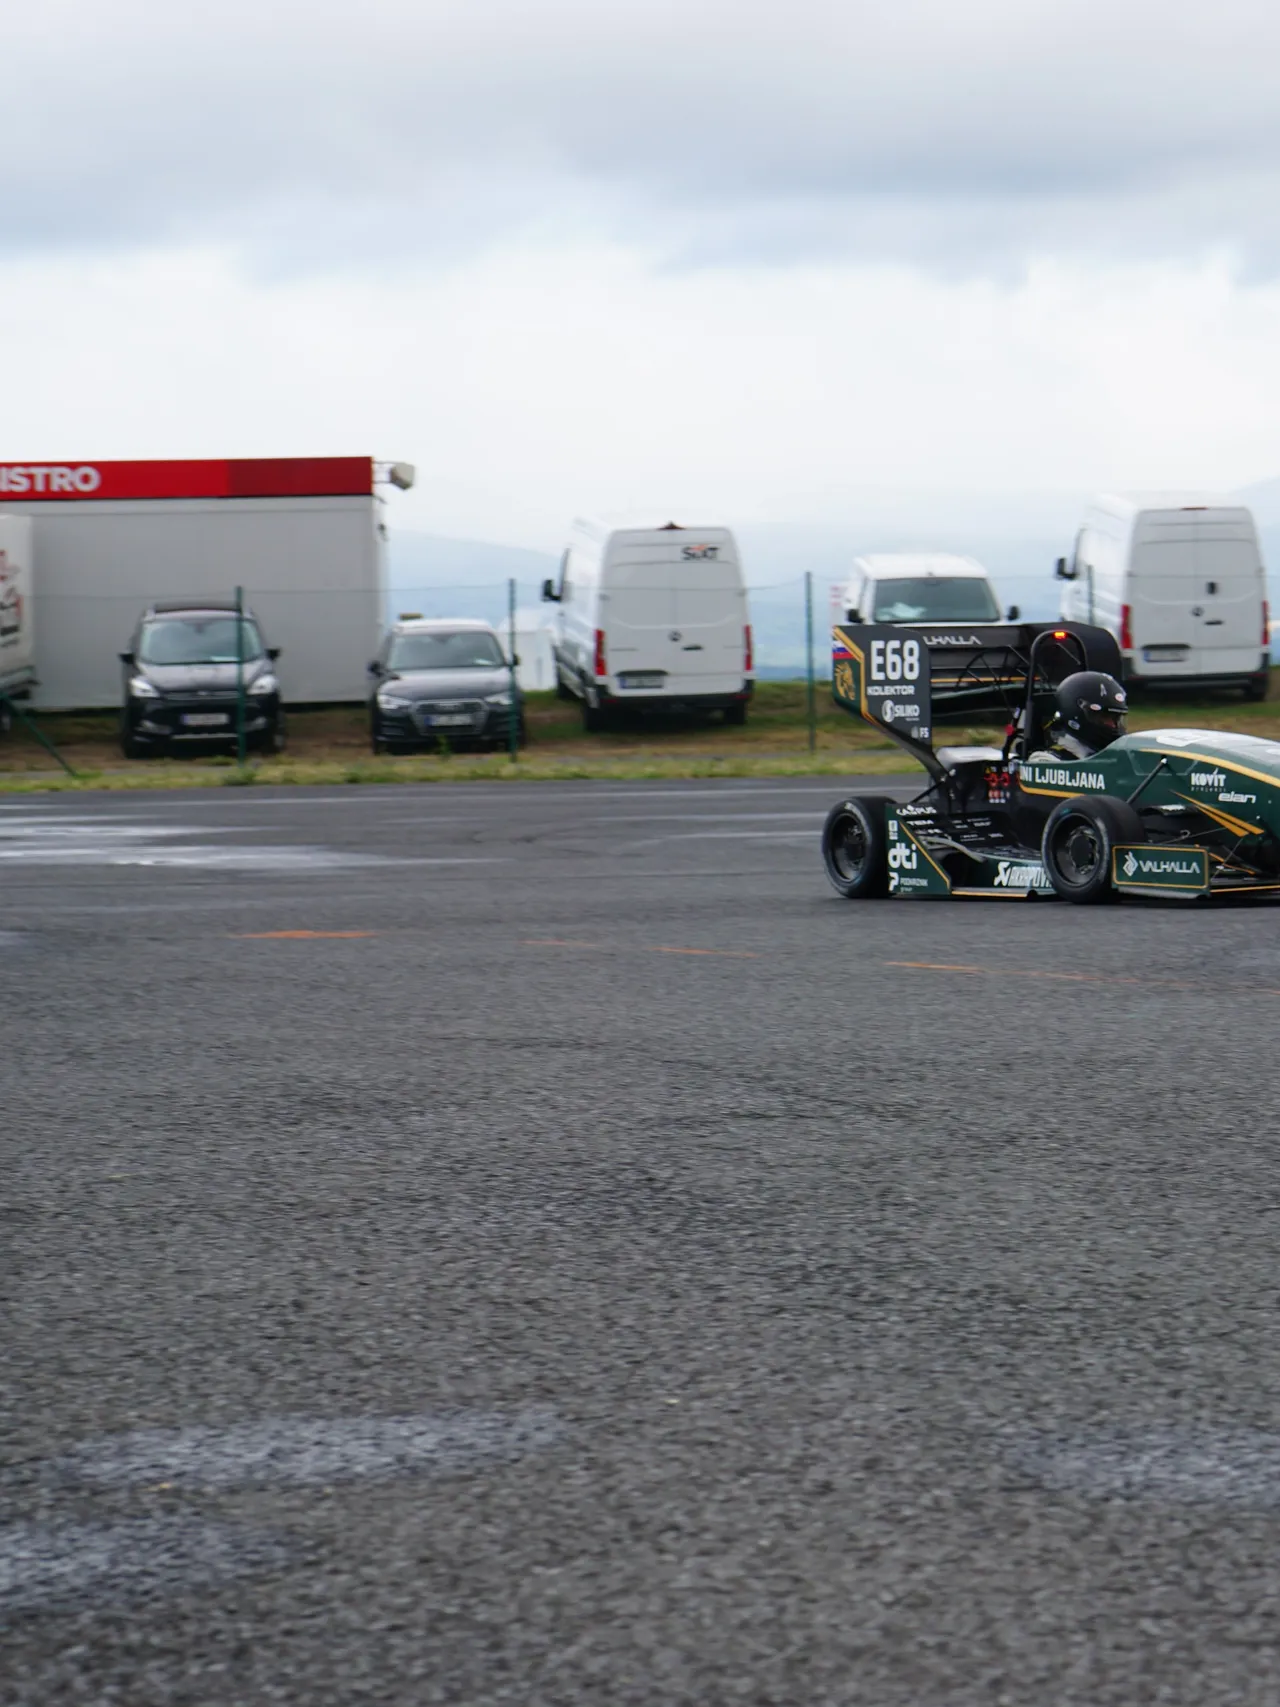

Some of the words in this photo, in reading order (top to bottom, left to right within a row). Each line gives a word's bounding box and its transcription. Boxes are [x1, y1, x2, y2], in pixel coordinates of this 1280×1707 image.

[871, 640, 920, 680] E68
[866, 686, 915, 695] KOLEKTOR
[1035, 767, 1106, 790] LJUBLJANA
[1218, 791, 1257, 804] elan
[888, 842, 918, 869] dti
[1139, 860, 1201, 874] VALHALLA
